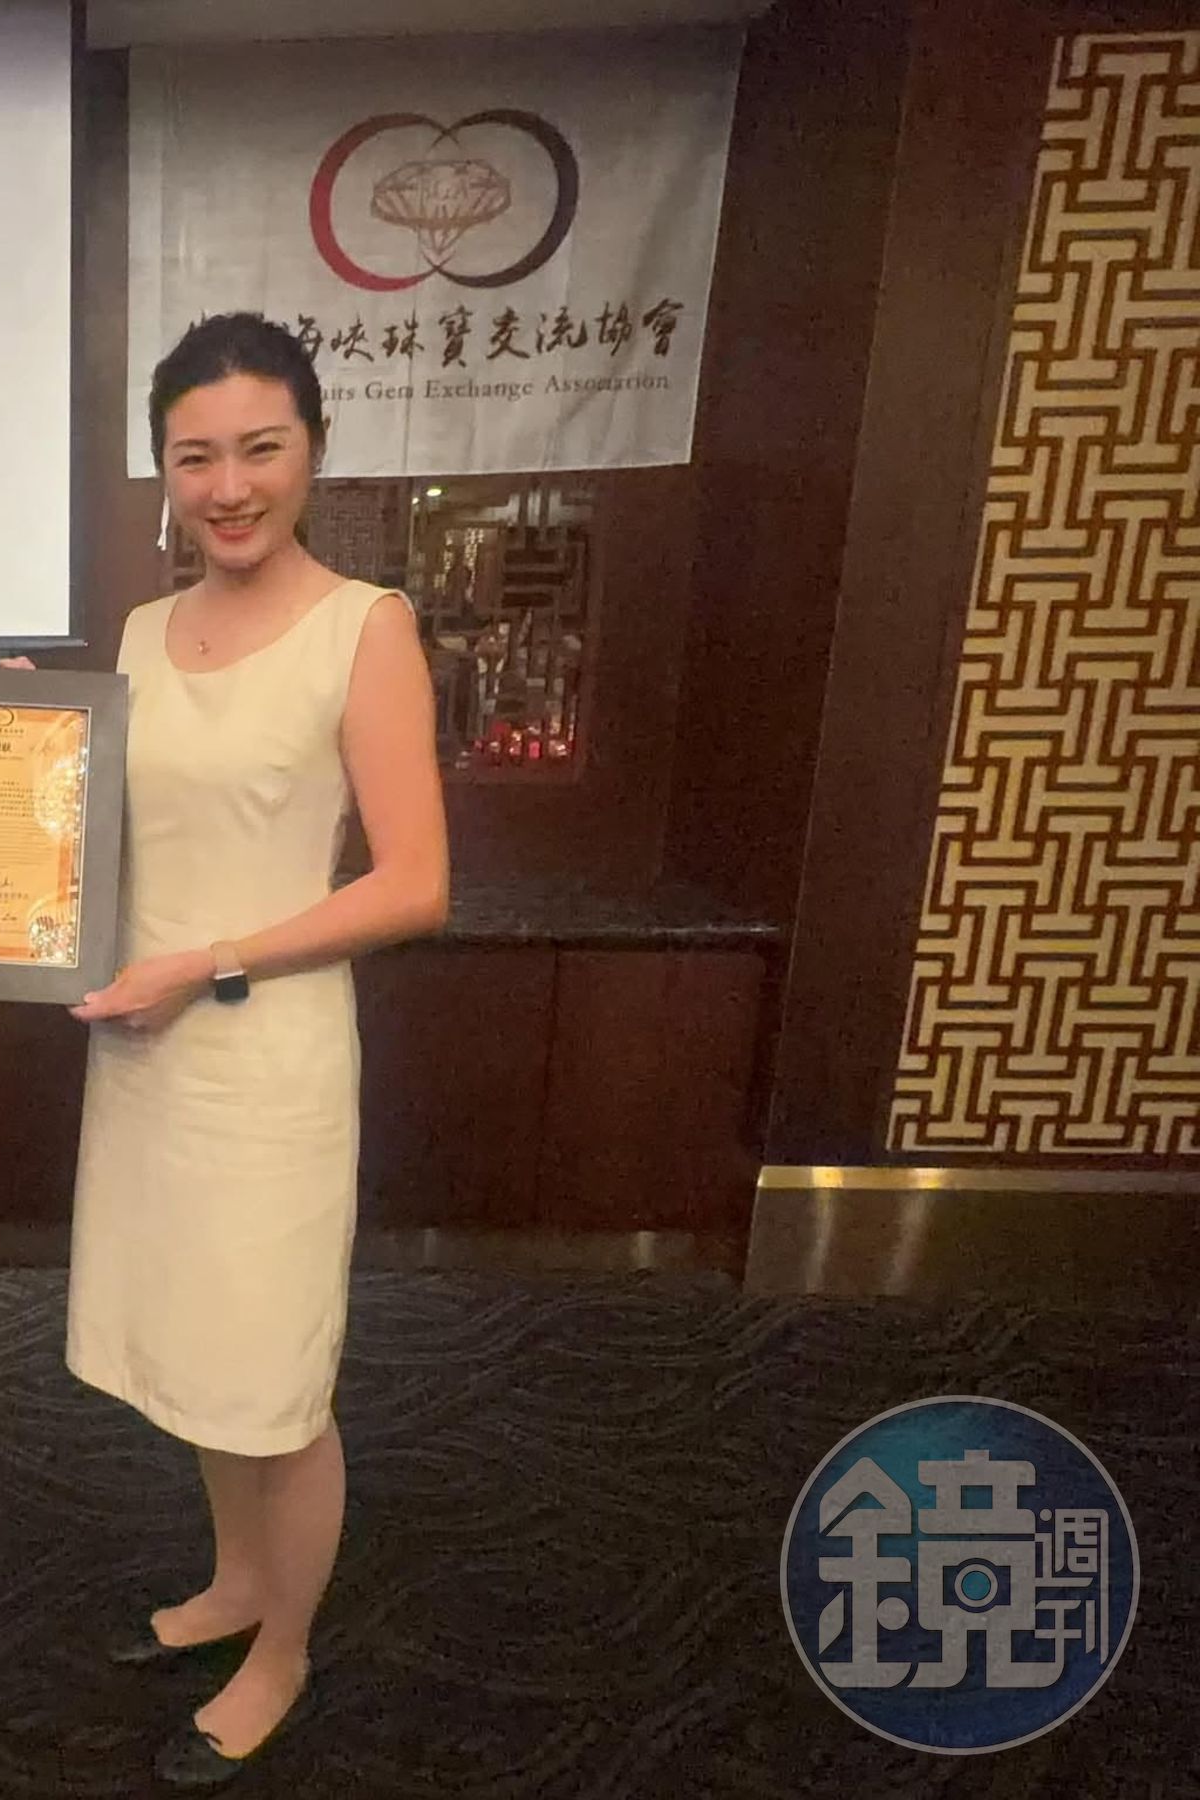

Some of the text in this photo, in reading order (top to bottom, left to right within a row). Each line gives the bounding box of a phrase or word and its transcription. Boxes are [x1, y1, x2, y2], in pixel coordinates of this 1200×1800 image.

[190, 298, 684, 368] 海峽珠寶交流協會
[365, 381, 414, 400] Gem
[424, 378, 534, 403] Exchange
[545, 374, 670, 395] Association
